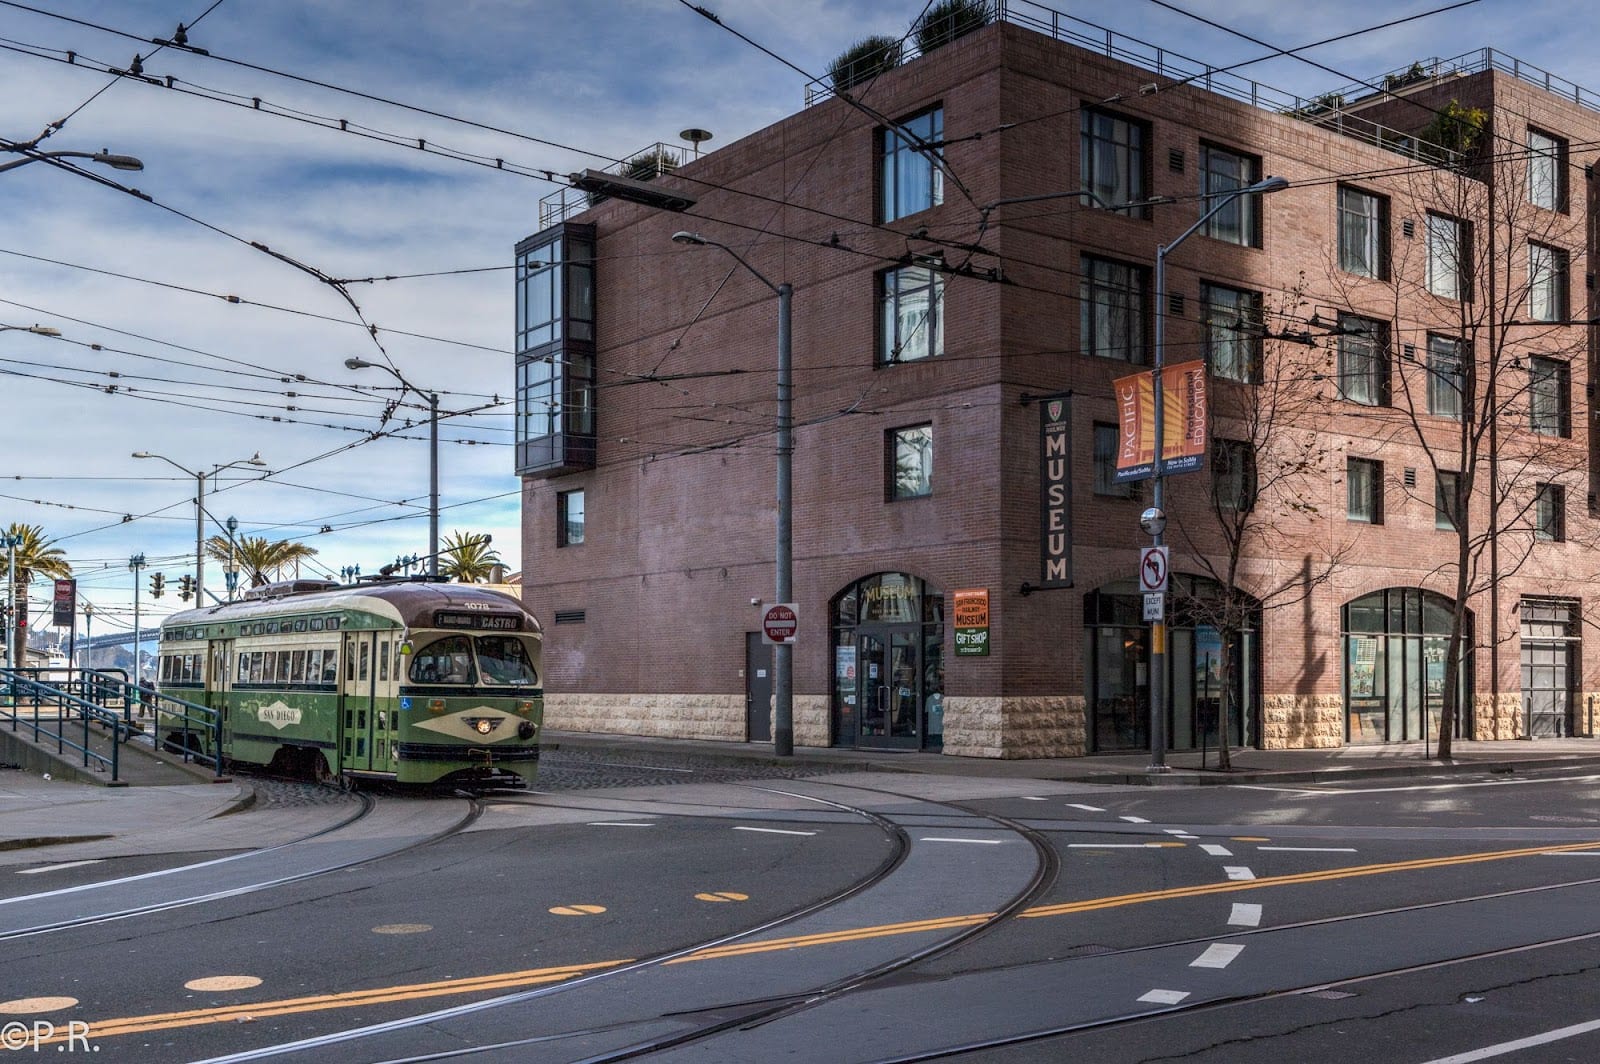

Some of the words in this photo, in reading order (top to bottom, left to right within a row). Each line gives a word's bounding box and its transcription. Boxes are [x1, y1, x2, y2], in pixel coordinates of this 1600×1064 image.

[1184, 371, 1195, 440] Professional
[1193, 368, 1206, 447] EDUCATION
[1121, 385, 1137, 459] PACIFIC
[1046, 433, 1067, 581] MUSEUM
[865, 585, 914, 601] MUSEUM
[464, 602, 490, 610] 1078
[1145, 597, 1161, 605] EXCEPT
[482, 615, 518, 629] CASTRO
[768, 611, 778, 620] DO
[780, 611, 792, 619] NOT
[956, 612, 986, 625] MUSEUM
[770, 628, 791, 637] ENTER
[956, 632, 970, 644] GIFT
[970, 631, 987, 644] SHOP
[263, 710, 274, 720] SAN
[276, 710, 295, 721] DIEGO
